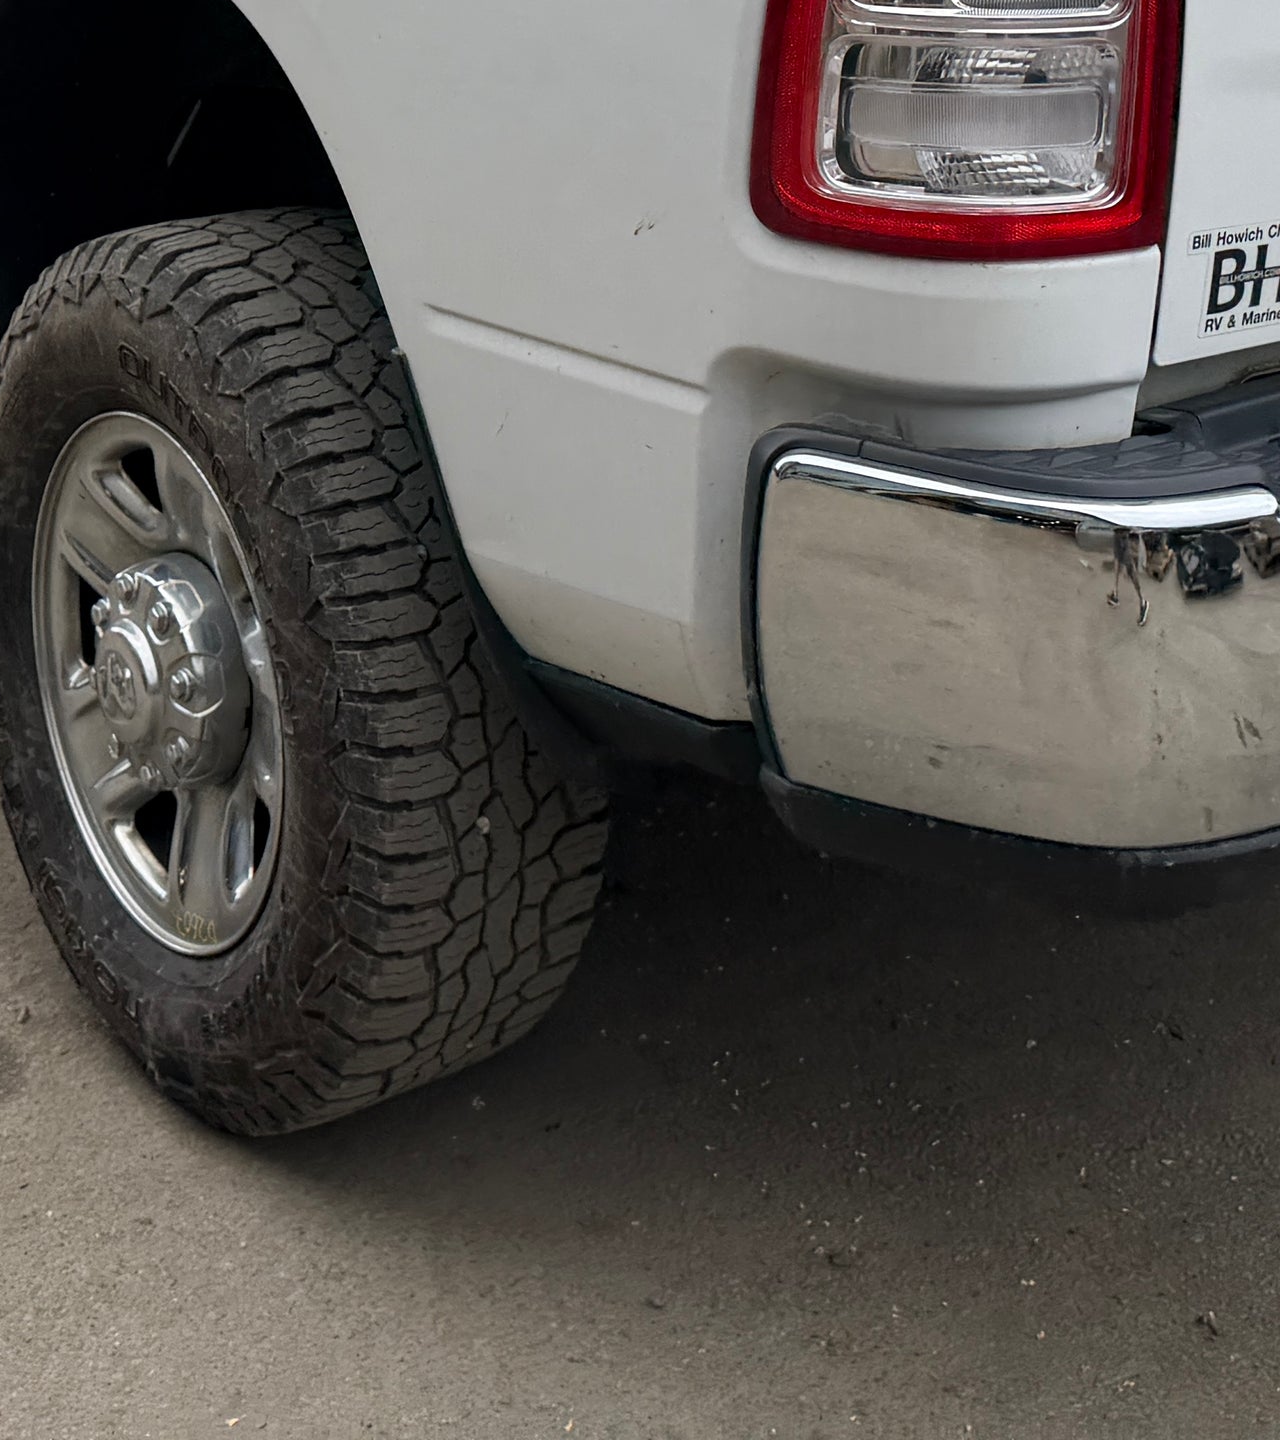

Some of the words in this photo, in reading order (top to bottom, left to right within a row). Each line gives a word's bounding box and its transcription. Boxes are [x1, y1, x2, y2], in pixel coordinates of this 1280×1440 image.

[1192, 233, 1211, 250] Bill
[1217, 227, 1263, 247] Howich
[1204, 316, 1223, 333] RV
[1227, 314, 1236, 329] &
